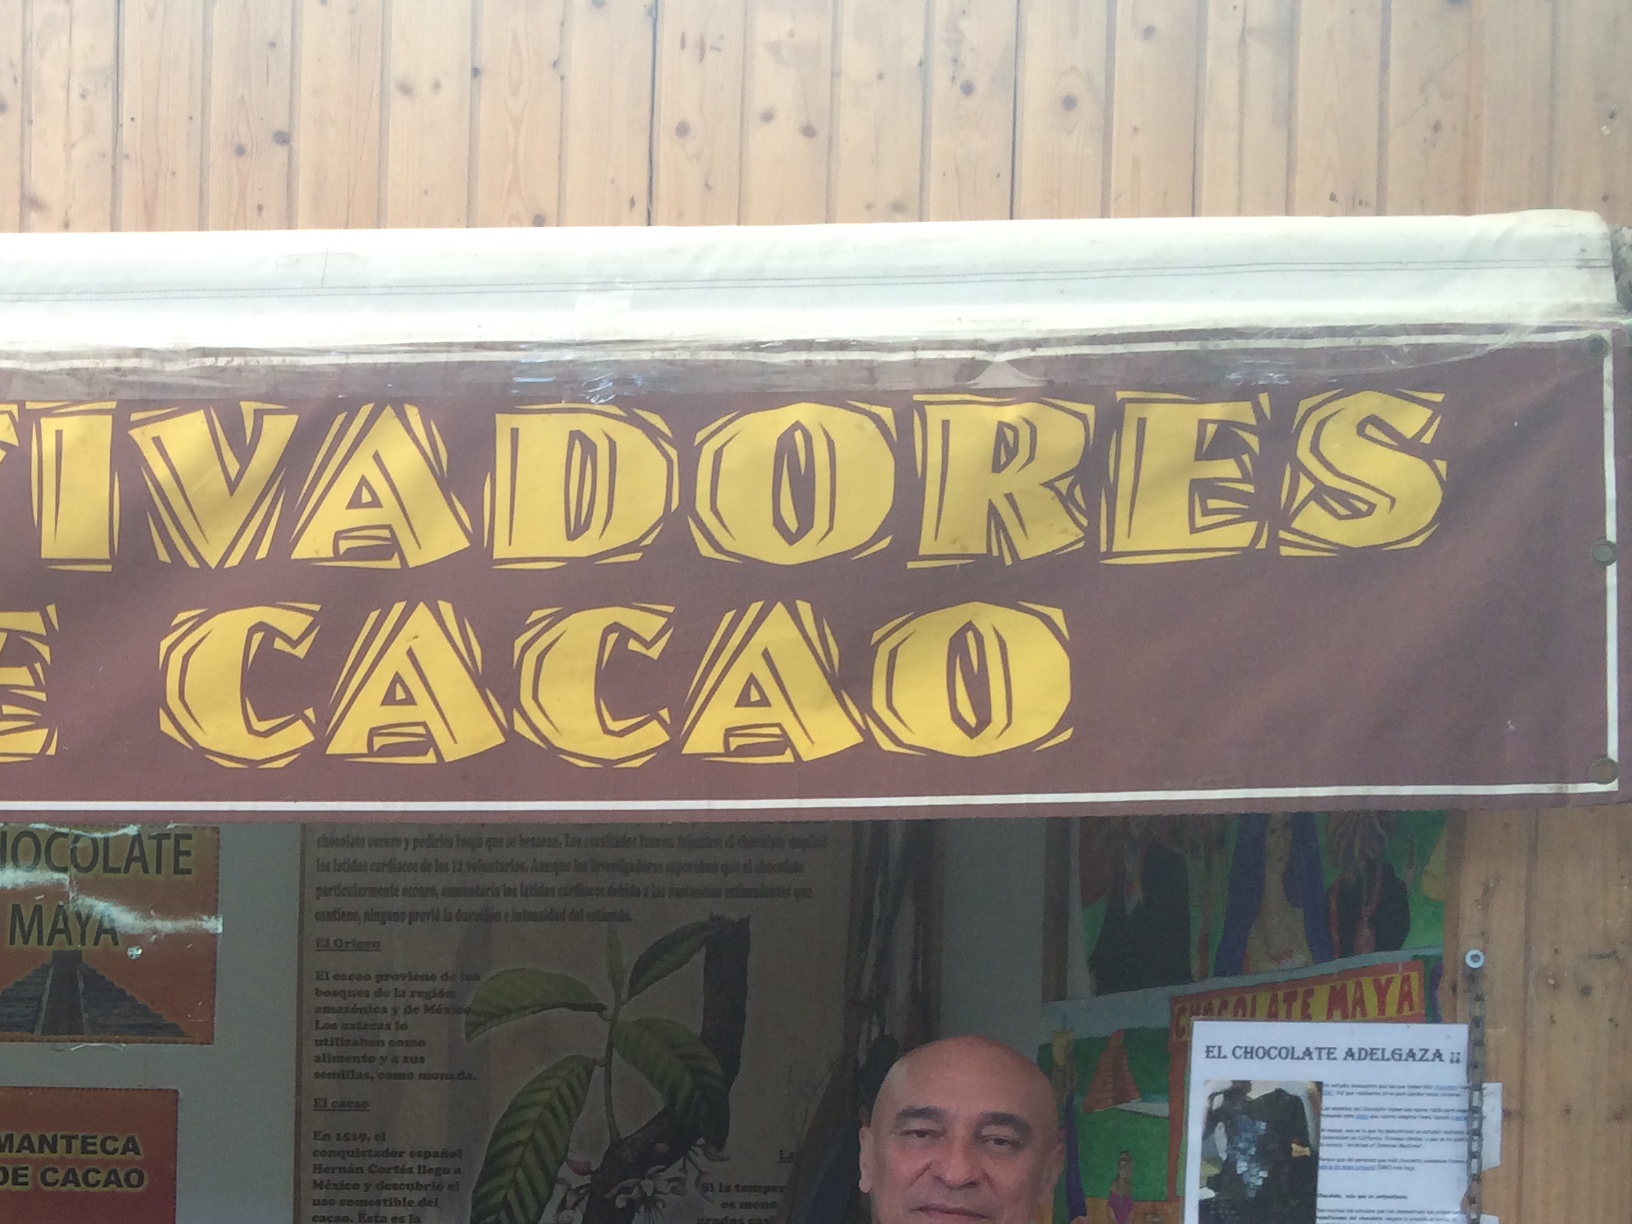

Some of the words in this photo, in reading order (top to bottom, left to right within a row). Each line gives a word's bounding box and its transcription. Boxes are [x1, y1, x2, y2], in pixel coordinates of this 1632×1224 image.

[159, 598, 1074, 767] CACAO
[9, 902, 120, 947] MAYA
[1326, 975, 1414, 1020] MAYA
[1204, 1046, 1228, 1060] EL
[1232, 1046, 1337, 1062] CHOCOLATE
[1344, 1047, 1444, 1063] ADELGAZA
[313, 1131, 331, 1141] En
[312, 1148, 405, 1159] conquistador
[409, 1148, 462, 1160] español
[40, 1167, 144, 1188] CACAO
[312, 1164, 364, 1174] Hernán
[368, 1164, 414, 1174] Cortés
[312, 1180, 359, 1190] México
